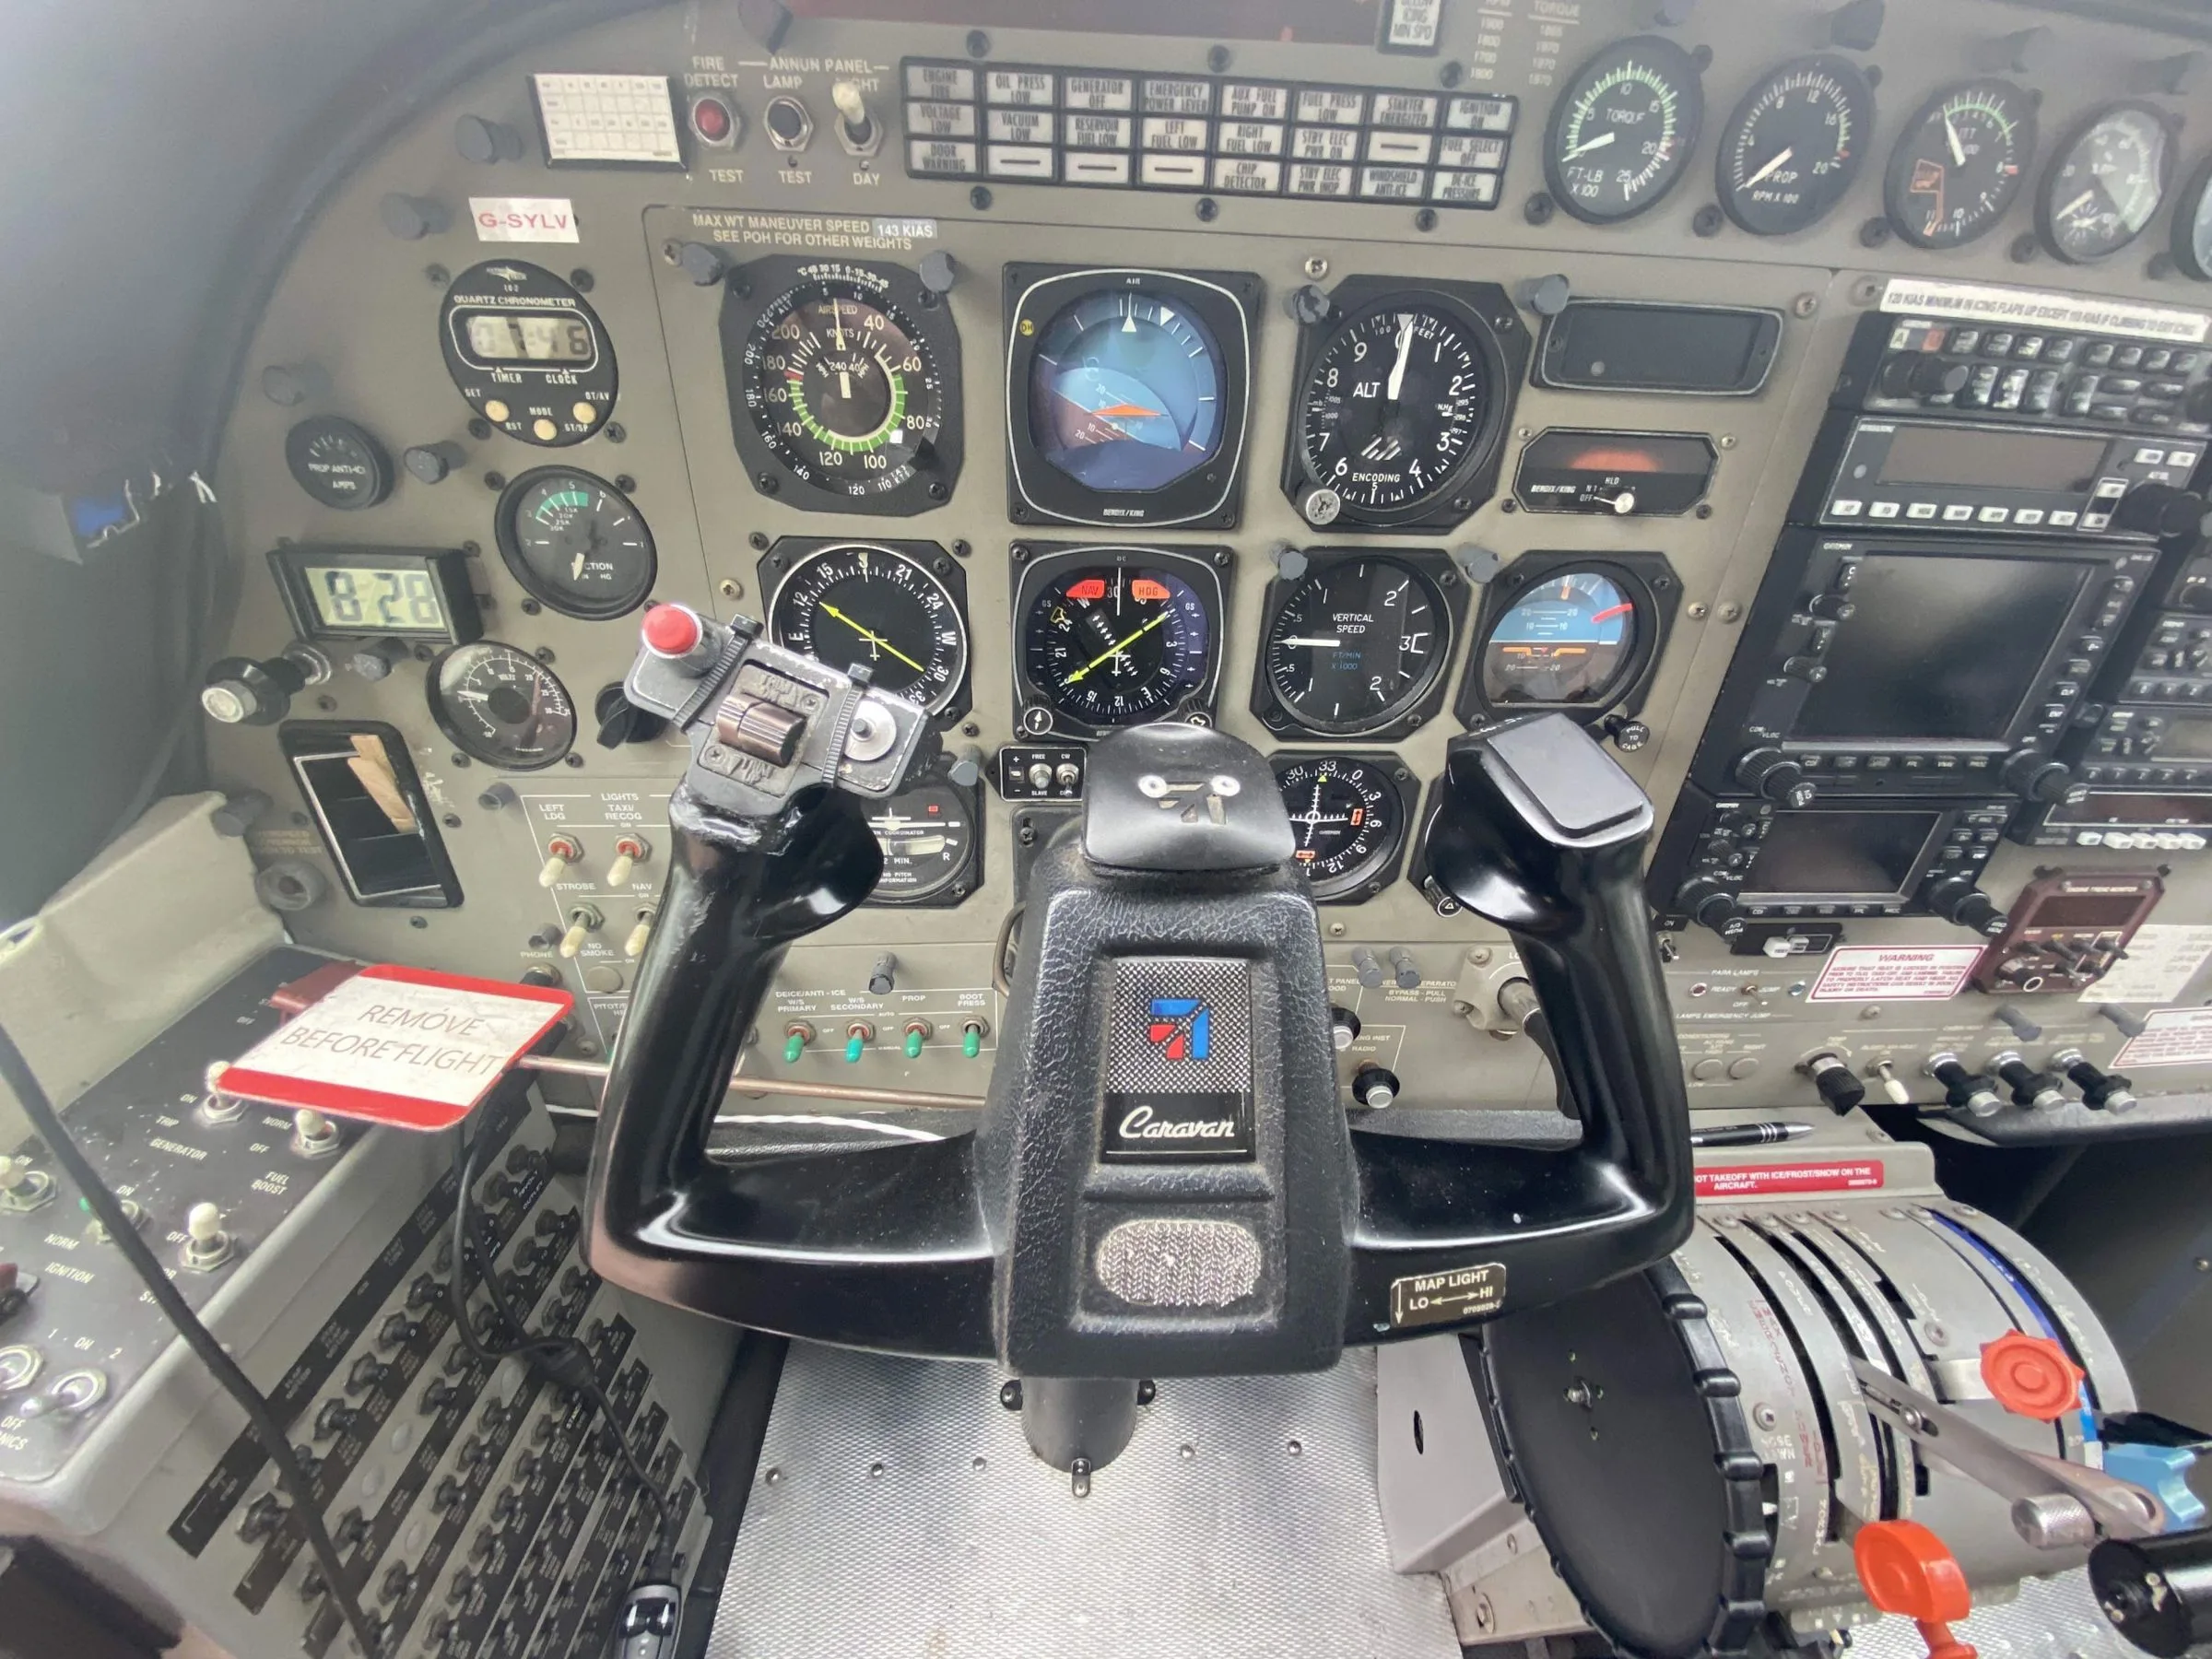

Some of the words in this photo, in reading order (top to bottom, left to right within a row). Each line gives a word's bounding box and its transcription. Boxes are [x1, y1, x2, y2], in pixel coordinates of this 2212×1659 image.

[693, 57, 724, 71] FIRE
[770, 59, 821, 72] ANNUN
[825, 60, 873, 74] PANEL
[685, 74, 737, 88] DETECT
[763, 76, 803, 89] LAMP
[995, 74, 1013, 89] OIL
[1018, 76, 1045, 90] PRESS
[1071, 80, 1123, 95] GENERATOR
[1011, 91, 1030, 104] LOW
[1149, 83, 1204, 98] EMERGENCY
[1256, 88, 1277, 102] FUEL
[1806, 91, 1820, 104] 12
[1089, 96, 1106, 109] OFF
[1330, 95, 1356, 109] PRESS
[1388, 97, 1424, 112] STARTER
[1460, 100, 1500, 115] IGNITION
[921, 105, 960, 120] VOLTAGE
[1231, 102, 1257, 116] PUMP
[1263, 104, 1276, 117] ON
[1319, 108, 1337, 121] LOW
[1001, 112, 1039, 127] VACUUM
[1075, 118, 1119, 134] RESERVOIR
[1381, 112, 1428, 127] ENERGIZED
[1825, 112, 1837, 126] 16
[932, 120, 951, 134] LOW
[1237, 124, 1264, 138] RIGHT
[1011, 128, 1030, 142] LOW
[1099, 134, 1117, 147] LOW
[1152, 135, 1172, 148] FUEL
[1179, 135, 1197, 148] LOW
[931, 145, 956, 158] DOOR
[1227, 138, 1247, 152] FUEL
[1253, 139, 1272, 153] LOW
[1329, 146, 1342, 159] ON
[922, 158, 966, 171] WARNING
[1236, 162, 1257, 176] CHIP
[1813, 161, 1829, 174] 20
[710, 170, 744, 183] TEST
[779, 171, 812, 184] TEST
[853, 173, 880, 186] DAY
[1224, 176, 1266, 190] DETECTOR
[1370, 169, 1418, 184] WINDSHIELD
[1375, 183, 1407, 197] ANTI-ICE
[1442, 187, 1480, 201] PRESSURE
[478, 213, 568, 229] G-SYLV
[693, 214, 722, 229] MAX
[725, 216, 747, 229] WT
[749, 216, 822, 231] MANEUVER
[825, 219, 870, 233] SPEED
[876, 224, 900, 236] 143
[901, 225, 934, 238] KIAS
[712, 229, 740, 243] SEE
[743, 230, 771, 245] POH
[774, 231, 801, 246] FOR
[806, 233, 850, 249] OTHER
[853, 236, 912, 252] WEIGHTS
[453, 295, 497, 305] QUARTZ
[498, 296, 576, 307] CHRONOMETER
[1998, 302, 2025, 316] FLAPS
[2037, 306, 2070, 320] EXCEPT
[864, 315, 885, 330] 40
[771, 325, 801, 340] 200
[1414, 325, 1435, 340] FEET
[903, 357, 923, 372] 60
[491, 373, 523, 383] TIMER
[546, 374, 578, 384] CLOCK
[465, 389, 481, 397] SET
[1353, 382, 1381, 398] ALT
[529, 407, 553, 416] MODE
[906, 415, 925, 430] 80
[819, 451, 843, 466] 120
[864, 454, 888, 470] 100
[1352, 472, 1402, 484] ENCODING
[1580, 494, 1594, 502] OFF
[817, 562, 834, 580] 15
[896, 563, 912, 580] 21
[1081, 586, 1100, 596] NAV
[1138, 587, 1159, 597] HDG
[926, 593, 945, 610] 24
[1185, 602, 1195, 611] GS
[1332, 613, 1375, 623] VERTICAL
[1336, 625, 1366, 634] SPEED
[1626, 725, 1644, 734] PULL
[1319, 760, 1336, 771] 33
[601, 793, 639, 801] LIGHTS
[539, 804, 564, 812] LEFT
[544, 812, 566, 820] LDG
[605, 812, 642, 820] RECOG
[581, 949, 615, 958] SMOKE
[1878, 954, 1936, 962] WARNING
[830, 1003, 884, 1011] SECONDARY
[236, 1016, 255, 1026] OFF
[358, 1004, 485, 1036] REMOVE
[280, 1027, 396, 1060] BEFORE
[399, 1041, 502, 1077] FLIGHT
[180, 1093, 197, 1104] ON
[155, 1114, 180, 1129] TRIP
[262, 1115, 293, 1132] NORM
[1118, 1104, 1236, 1139] Caravan
[149, 1136, 208, 1161] GENERATOR
[249, 1143, 270, 1155] OFF
[14, 1154, 33, 1167] ON
[265, 1170, 290, 1185] FUEL
[1709, 1172, 1747, 1182] TAKEOFF
[1748, 1171, 1770, 1181] WITH
[1771, 1169, 1839, 1180] ICE/FROST/SNOW
[1841, 1168, 1853, 1177] ON
[1854, 1168, 1871, 1176] THE
[116, 1184, 135, 1197] ON
[252, 1178, 288, 1196] BOOST
[1713, 1181, 1759, 1191] AIRCRAFT.
[43, 1233, 80, 1251] NORM
[166, 1230, 188, 1244] OFF
[45, 1261, 96, 1285] IGNITION
[1415, 1276, 1446, 1293] MAP
[1449, 1269, 1490, 1288] LIGHT
[1479, 1286, 1494, 1299] HI
[1409, 1297, 1430, 1312] LO
[74, 1337, 95, 1351] ON
[1, 1415, 26, 1430] OFF
